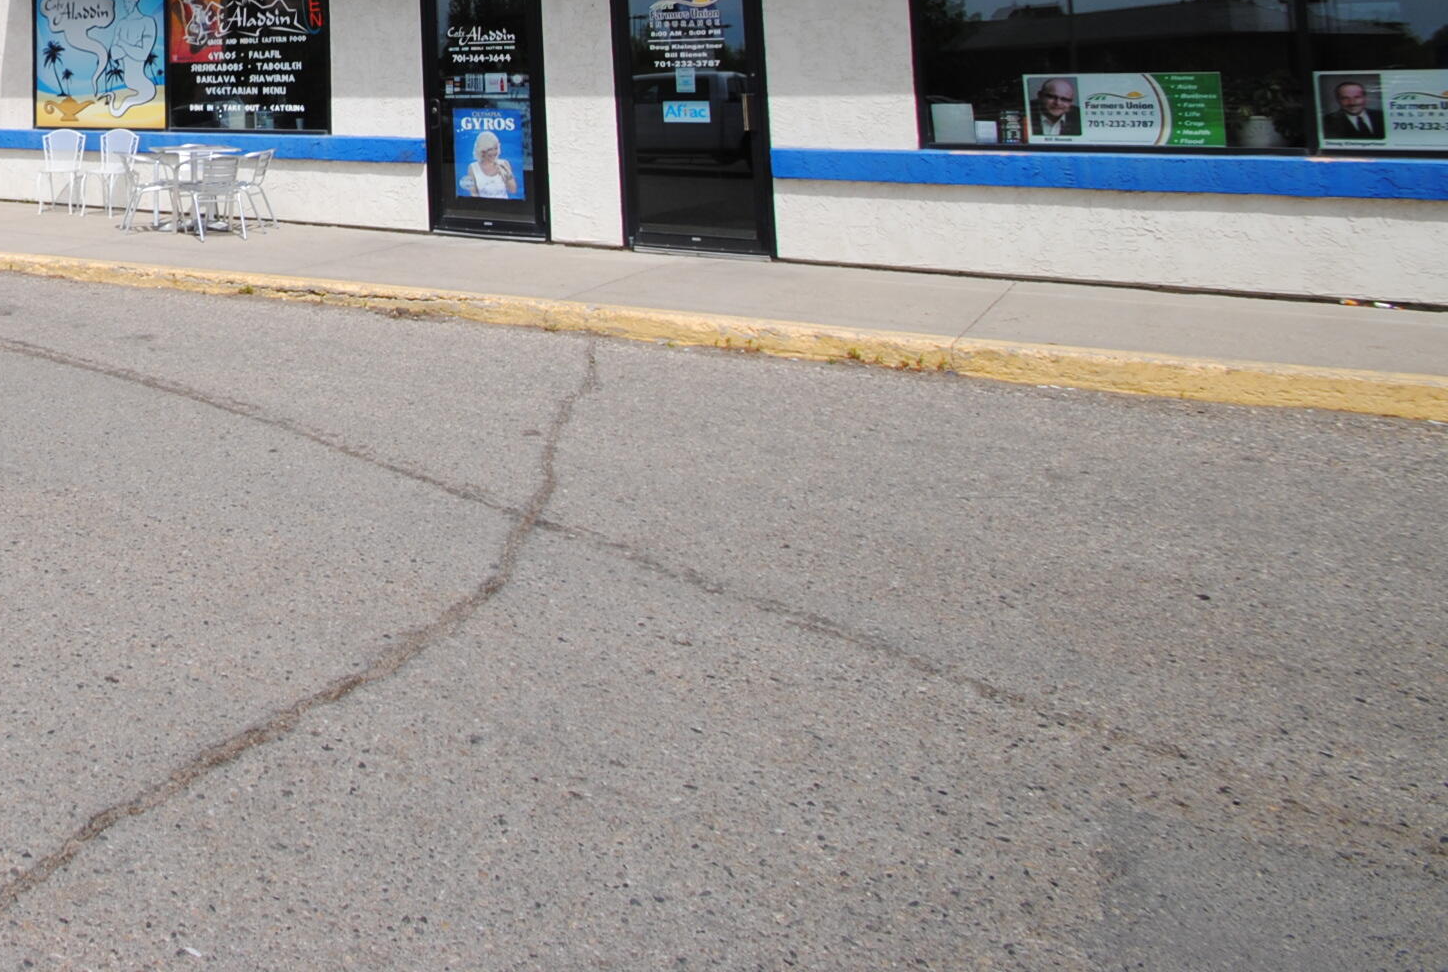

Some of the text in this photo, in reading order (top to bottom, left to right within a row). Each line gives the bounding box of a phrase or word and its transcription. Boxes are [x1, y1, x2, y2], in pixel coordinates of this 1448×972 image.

[52, 1, 109, 26] Aladdin
[690, 8, 720, 19] Union
[219, 6, 291, 33] Aladdin
[458, 26, 516, 45] Aladdin
[208, 51, 236, 60] GYROS
[654, 59, 721, 68] 701-232-3787
[196, 75, 236, 84] BAKLAVA
[205, 86, 287, 95] VEGETARIAN MENU
[1126, 101, 1154, 109] Union
[460, 117, 516, 131] GYROS
[1088, 120, 1154, 128] 701-232-3787
[1393, 122, 1448, 131] 701-232-
